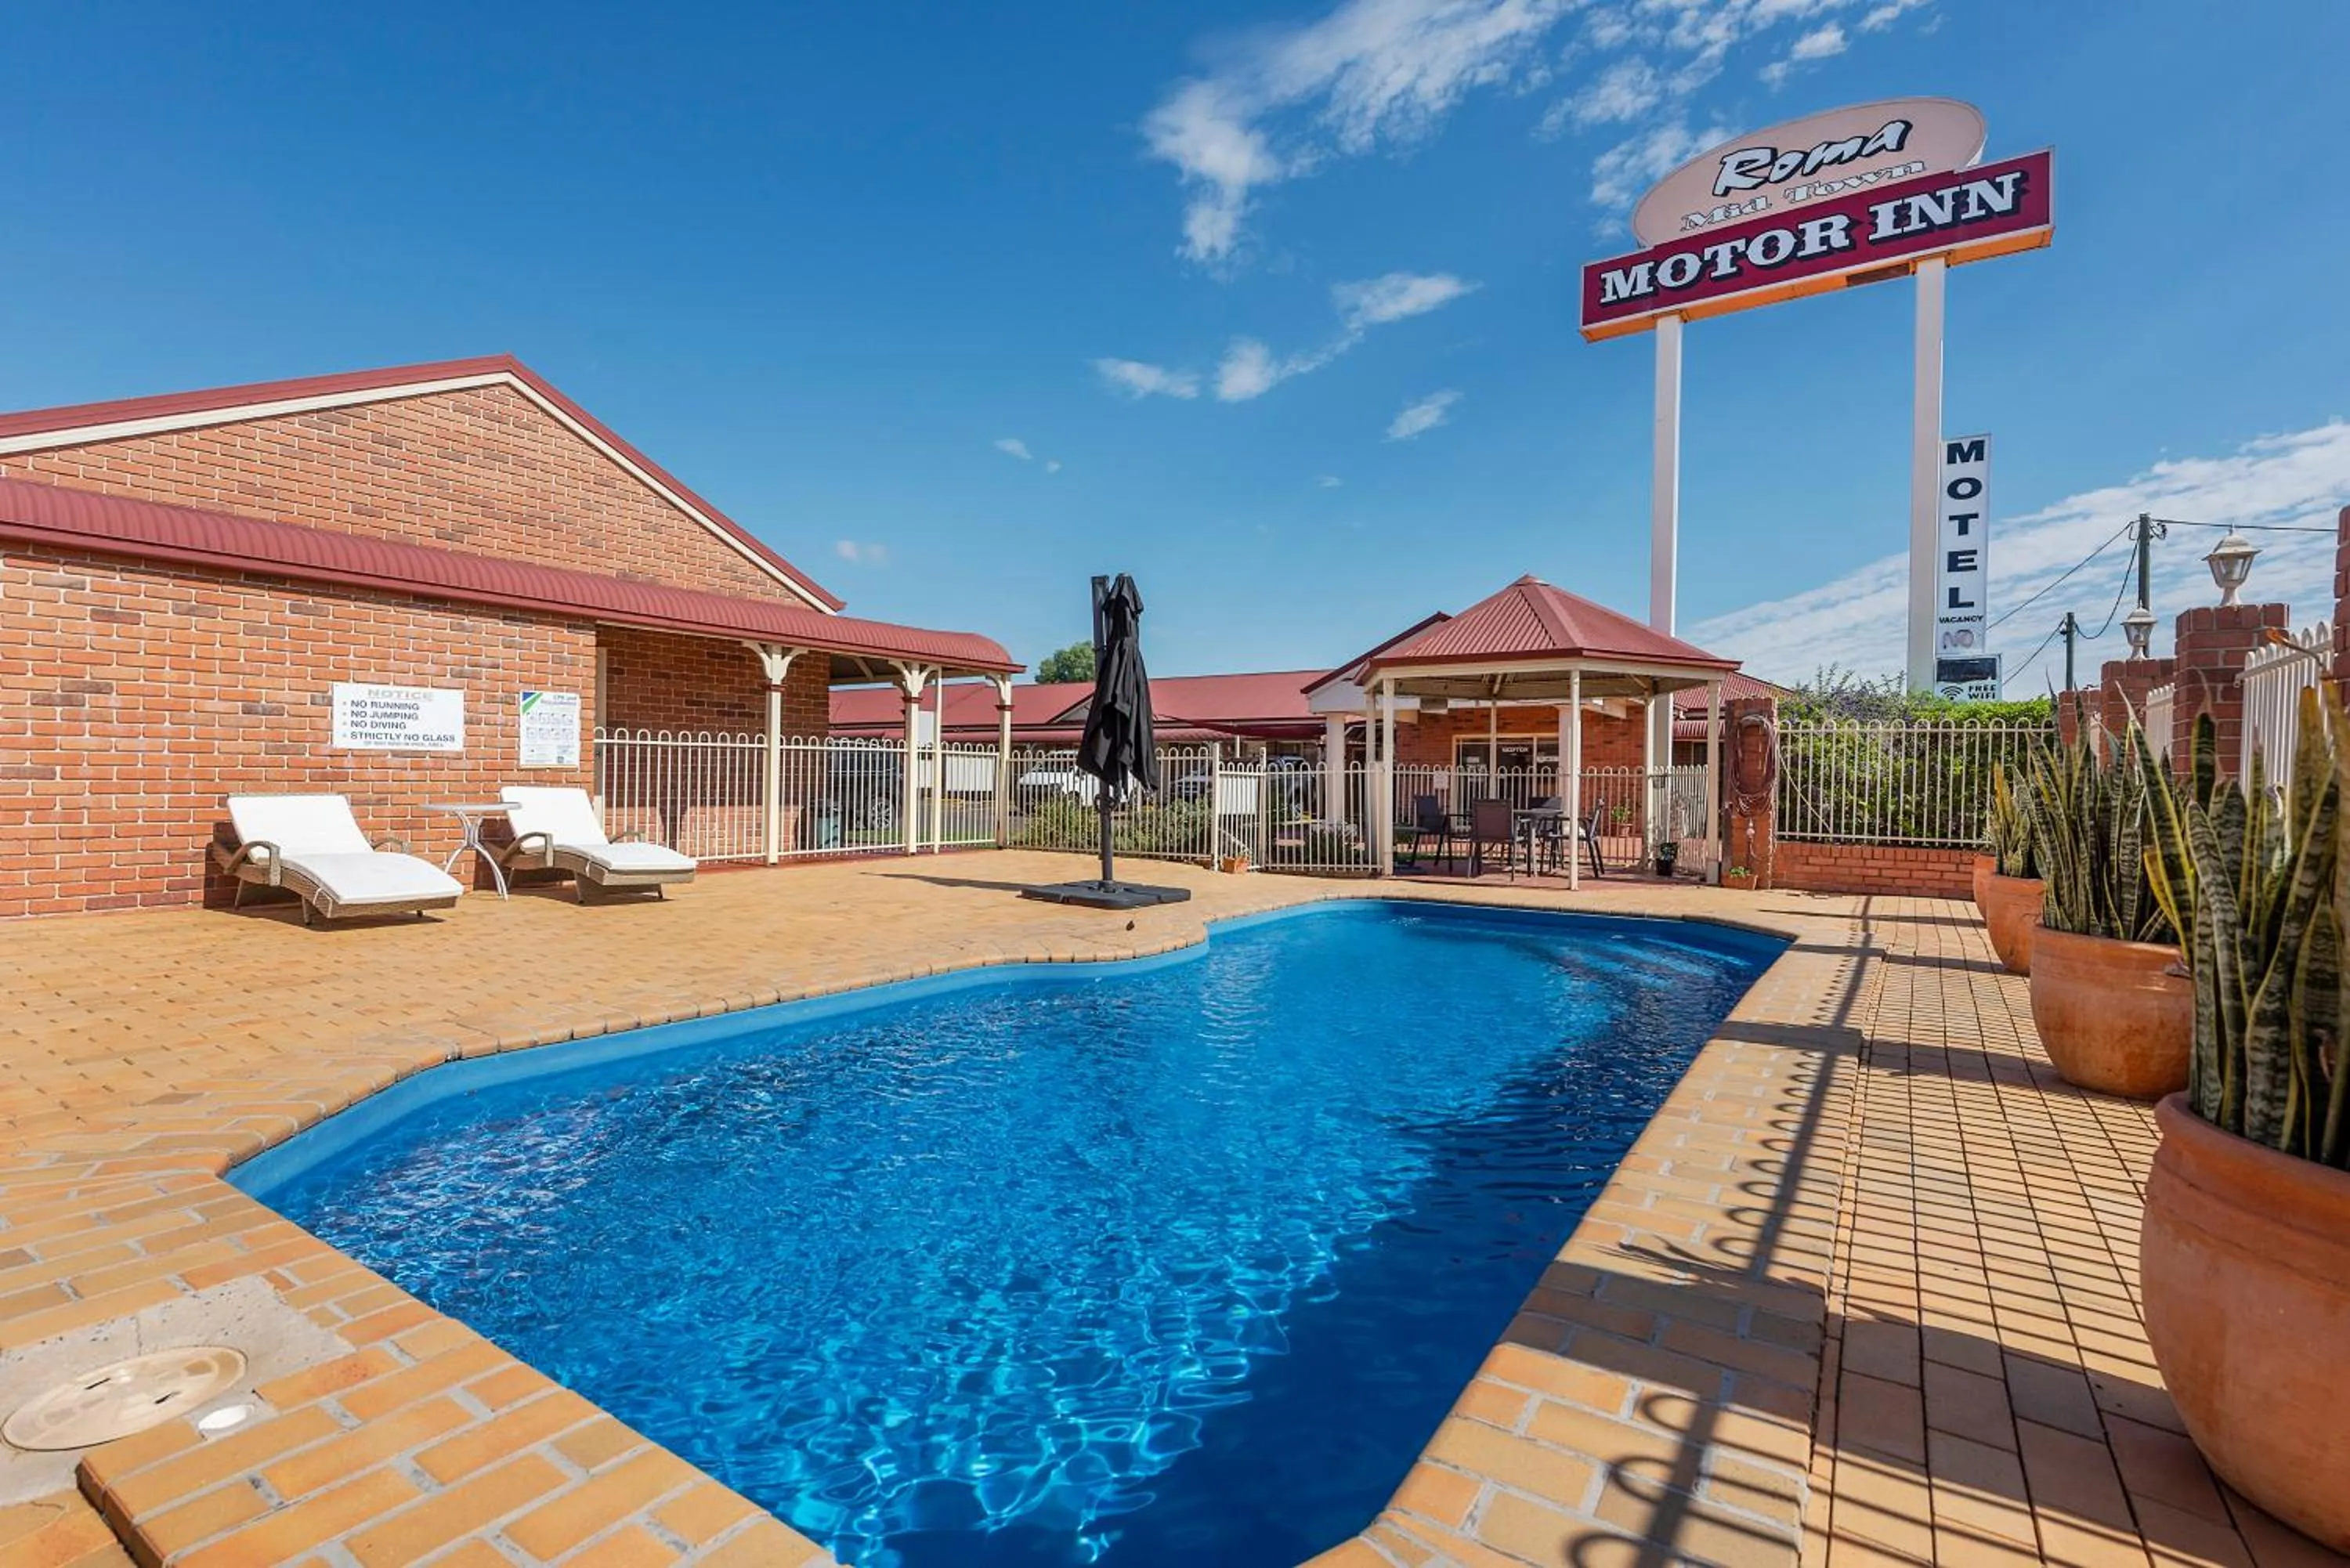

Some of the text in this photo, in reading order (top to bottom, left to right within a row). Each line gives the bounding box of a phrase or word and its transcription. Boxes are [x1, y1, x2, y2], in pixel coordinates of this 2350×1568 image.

[1712, 120, 1913, 196] Roma
[1680, 161, 1926, 232] Mid Town
[1600, 172, 2023, 304] MOTOR INN
[1947, 439, 1985, 609] MOTEL
[1939, 615, 1983, 623] VACANCY
[368, 688, 433, 701] NOTICE
[350, 699, 420, 710] NO RUNNING
[370, 711, 418, 721] JUMPING
[350, 720, 367, 728] NO
[350, 731, 455, 743] STRICTLY NO GLASS
